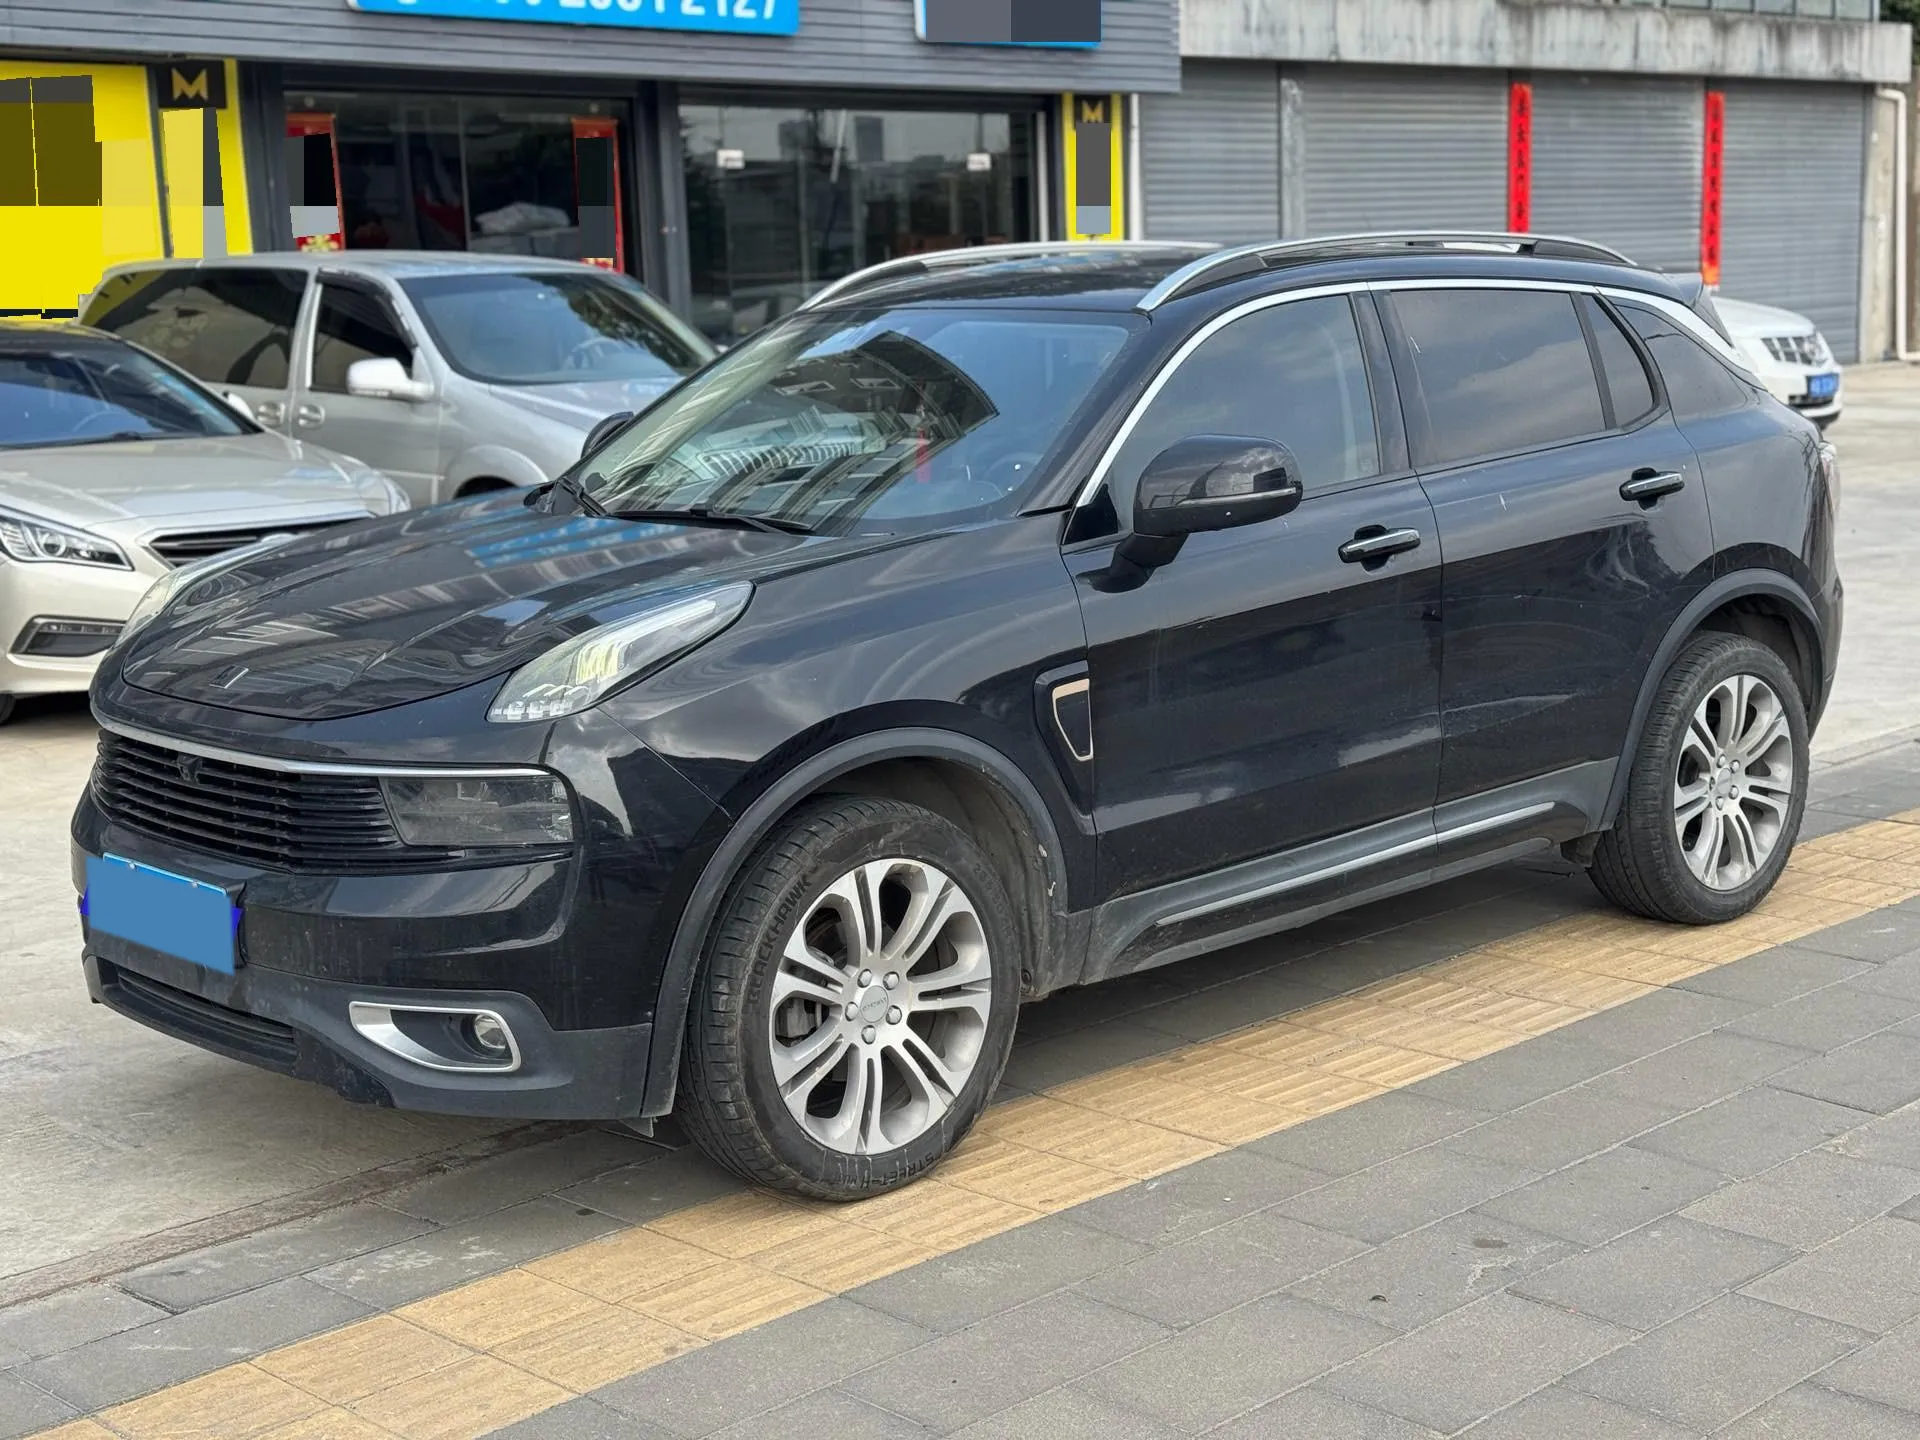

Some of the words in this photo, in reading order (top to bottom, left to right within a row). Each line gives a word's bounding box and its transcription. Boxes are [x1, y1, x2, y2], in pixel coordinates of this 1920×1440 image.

[171, 67, 208, 102] M
[1081, 100, 1104, 123] M
[748, 873, 812, 1004] BLACKHAWK
